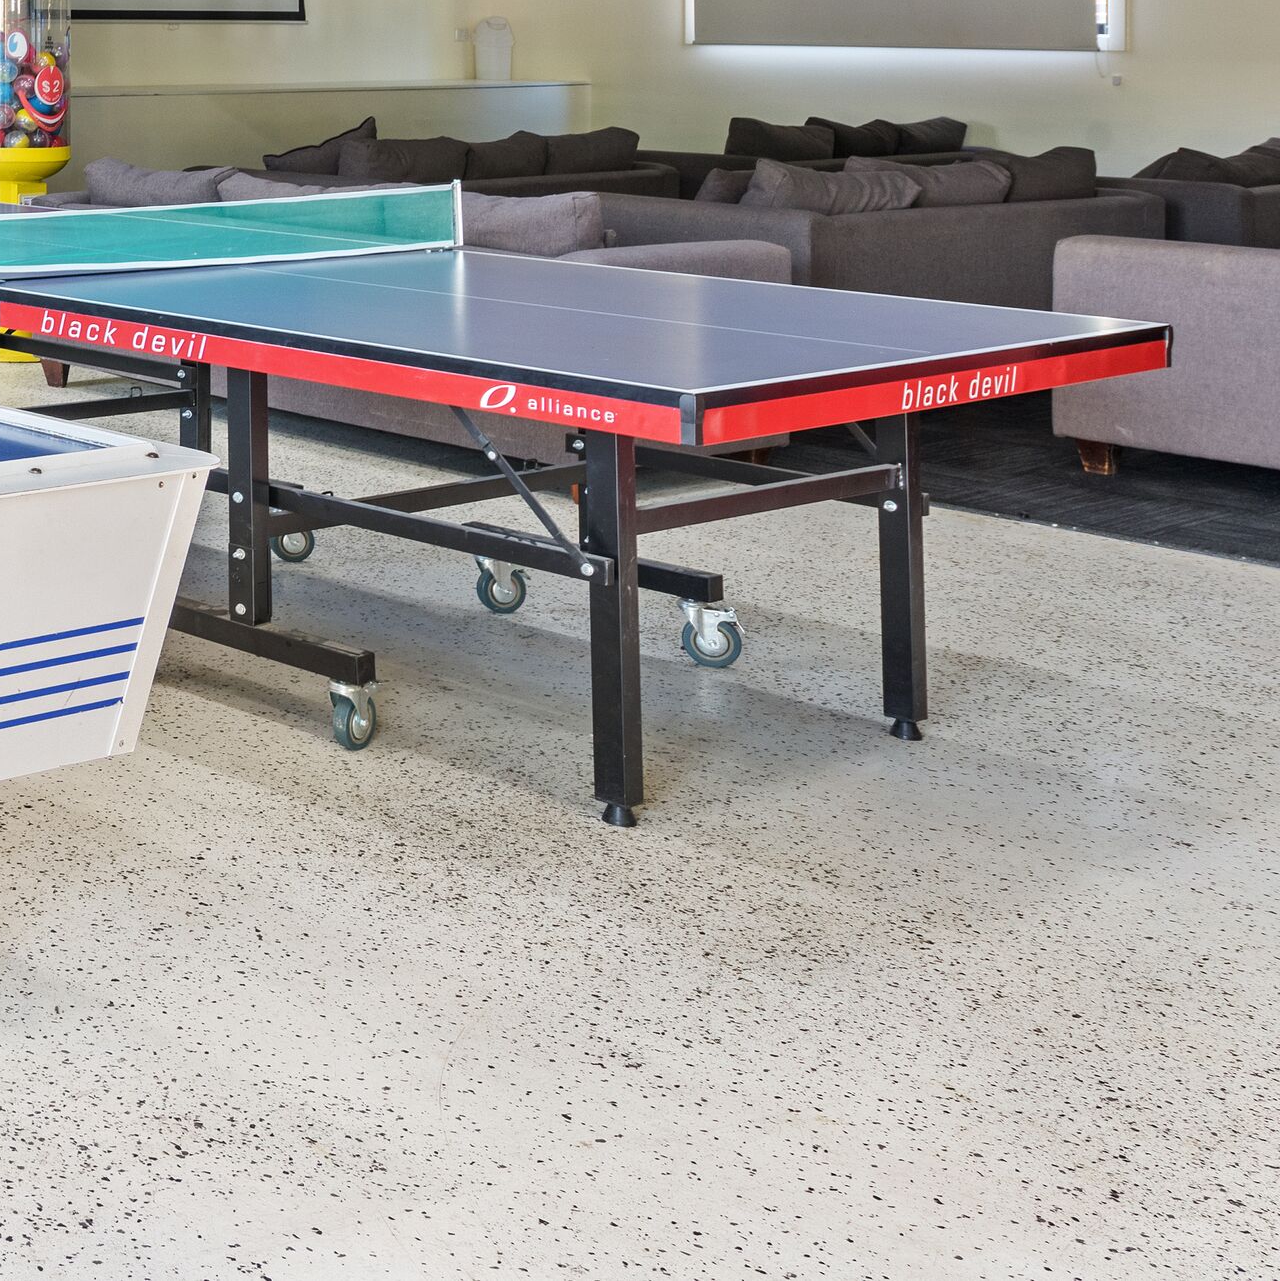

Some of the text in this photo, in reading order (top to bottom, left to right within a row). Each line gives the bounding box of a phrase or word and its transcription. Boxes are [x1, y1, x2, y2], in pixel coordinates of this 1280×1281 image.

[38, 309, 207, 360] black devil
[526, 396, 616, 424] alliance
[900, 365, 1018, 411] black devil
